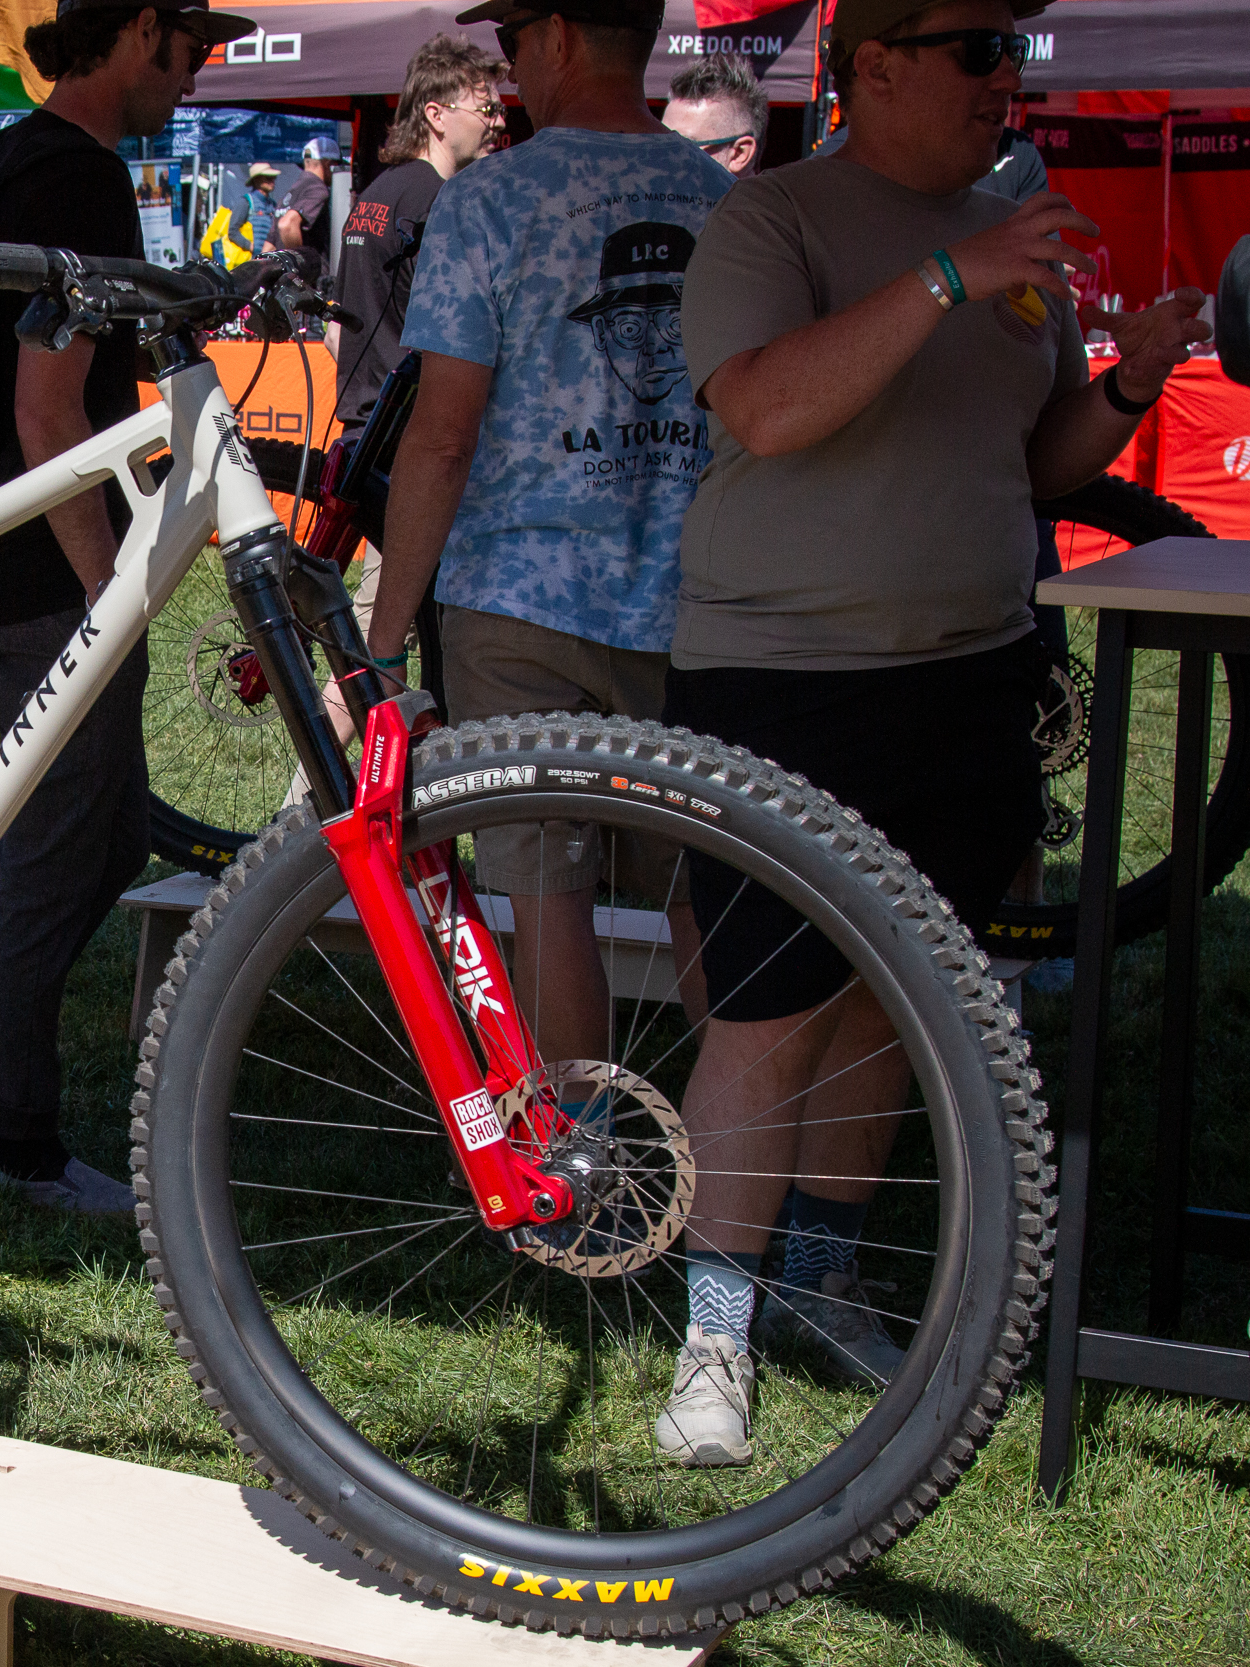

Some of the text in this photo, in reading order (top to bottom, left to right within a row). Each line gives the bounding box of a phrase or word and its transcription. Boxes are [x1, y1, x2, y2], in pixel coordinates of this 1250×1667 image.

[668, 34, 782, 55] XPEDO.COM
[1174, 135, 1239, 154] SADDLES
[565, 201, 601, 220] WHICH
[603, 195, 624, 207] WAY
[626, 193, 640, 203] TO
[644, 192, 704, 206] MADONNA'S
[631, 243, 669, 262] LRC
[561, 427, 603, 454] LA
[583, 454, 639, 476] DON'T
[644, 451, 673, 467] ASK
[585, 480, 601, 488] I'M
[604, 475, 622, 486] NOT
[625, 472, 647, 484] FROM
[682, 477, 699, 488] HER
[370, 734, 385, 784] ULTIMATE
[547, 768, 601, 780] 29X2.50WT
[560, 776, 573, 784] 50
[610, 776, 629, 790] 3C
[412, 764, 537, 811] ASSEGAI
[629, 783, 661, 797] terra
[665, 789, 687, 806] EXO
[689, 797, 722, 818] TR
[455, 1093, 494, 1123] ROCK
[466, 1117, 502, 1145] SHOX
[458, 1552, 675, 1604] MAXXIS
